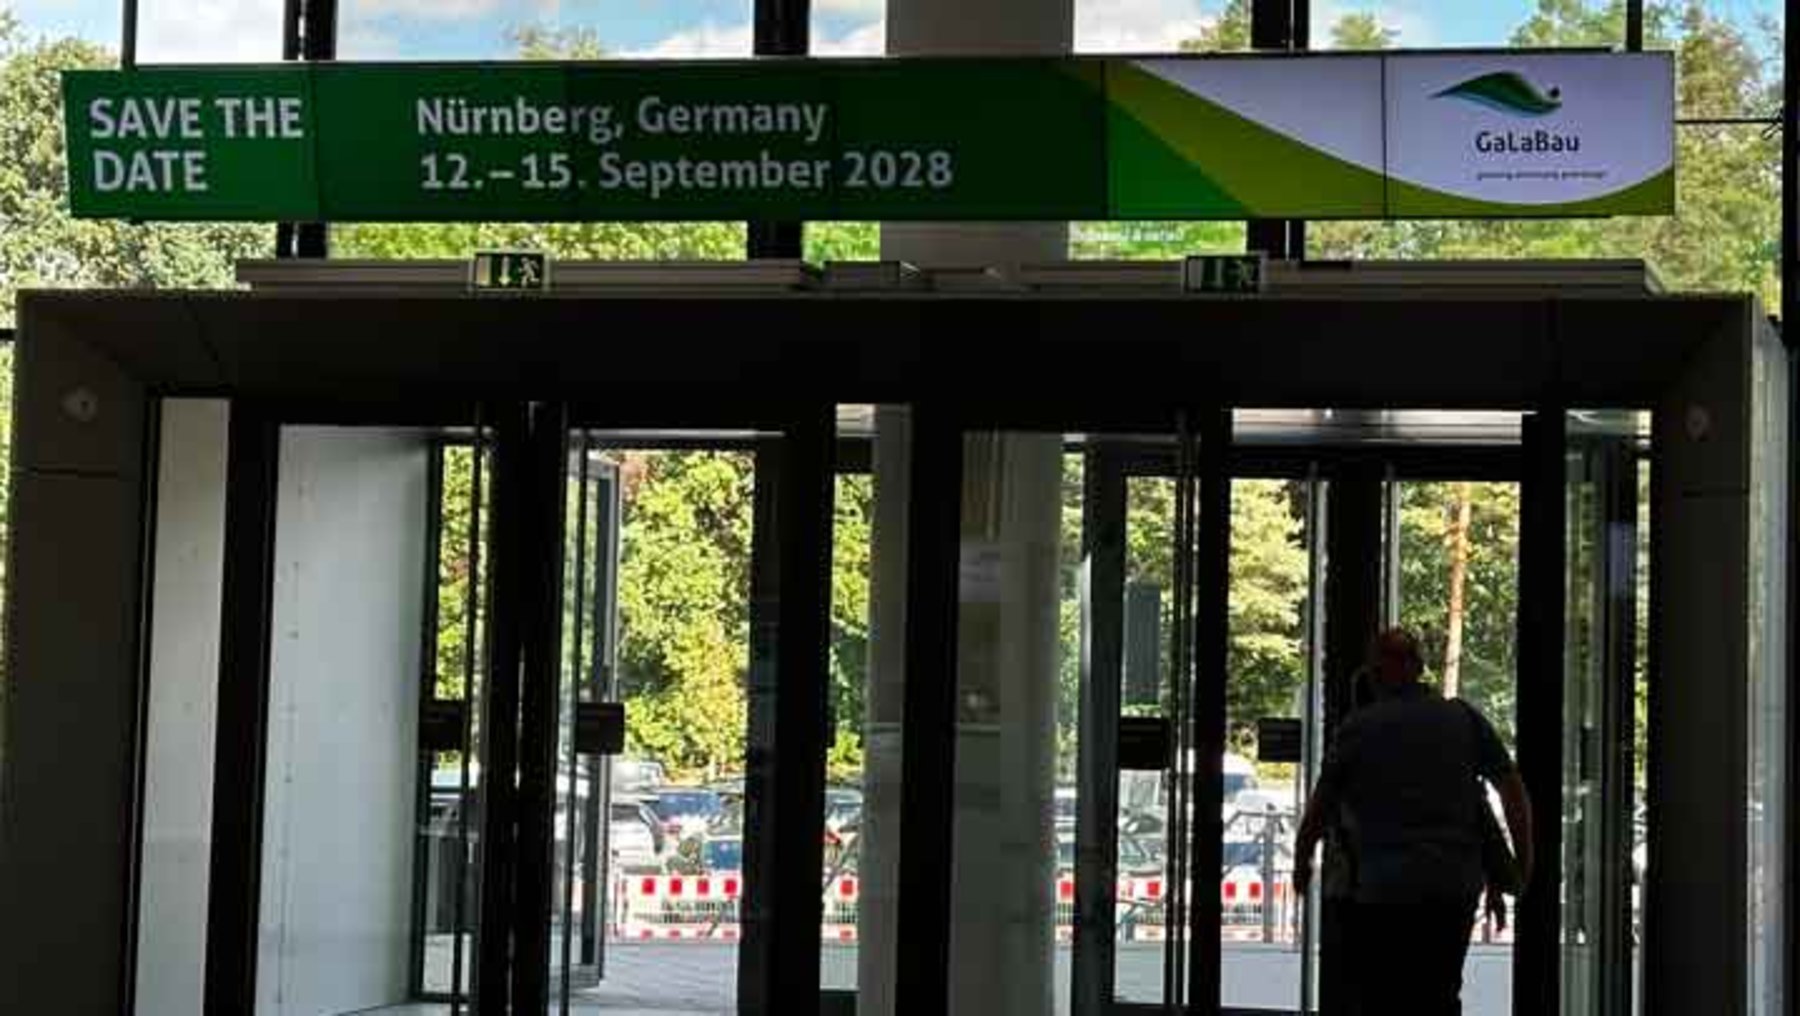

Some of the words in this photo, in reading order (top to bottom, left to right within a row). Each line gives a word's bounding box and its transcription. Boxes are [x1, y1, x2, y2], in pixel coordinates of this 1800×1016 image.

[89, 97, 203, 139] SAVE
[215, 97, 304, 138] THE
[417, 96, 624, 144] Nürnberg,
[637, 96, 828, 141] Germany
[1475, 130, 1580, 153] GaLaBau
[93, 151, 208, 191] DATE
[599, 150, 831, 198] September
[843, 151, 953, 187] 2028
